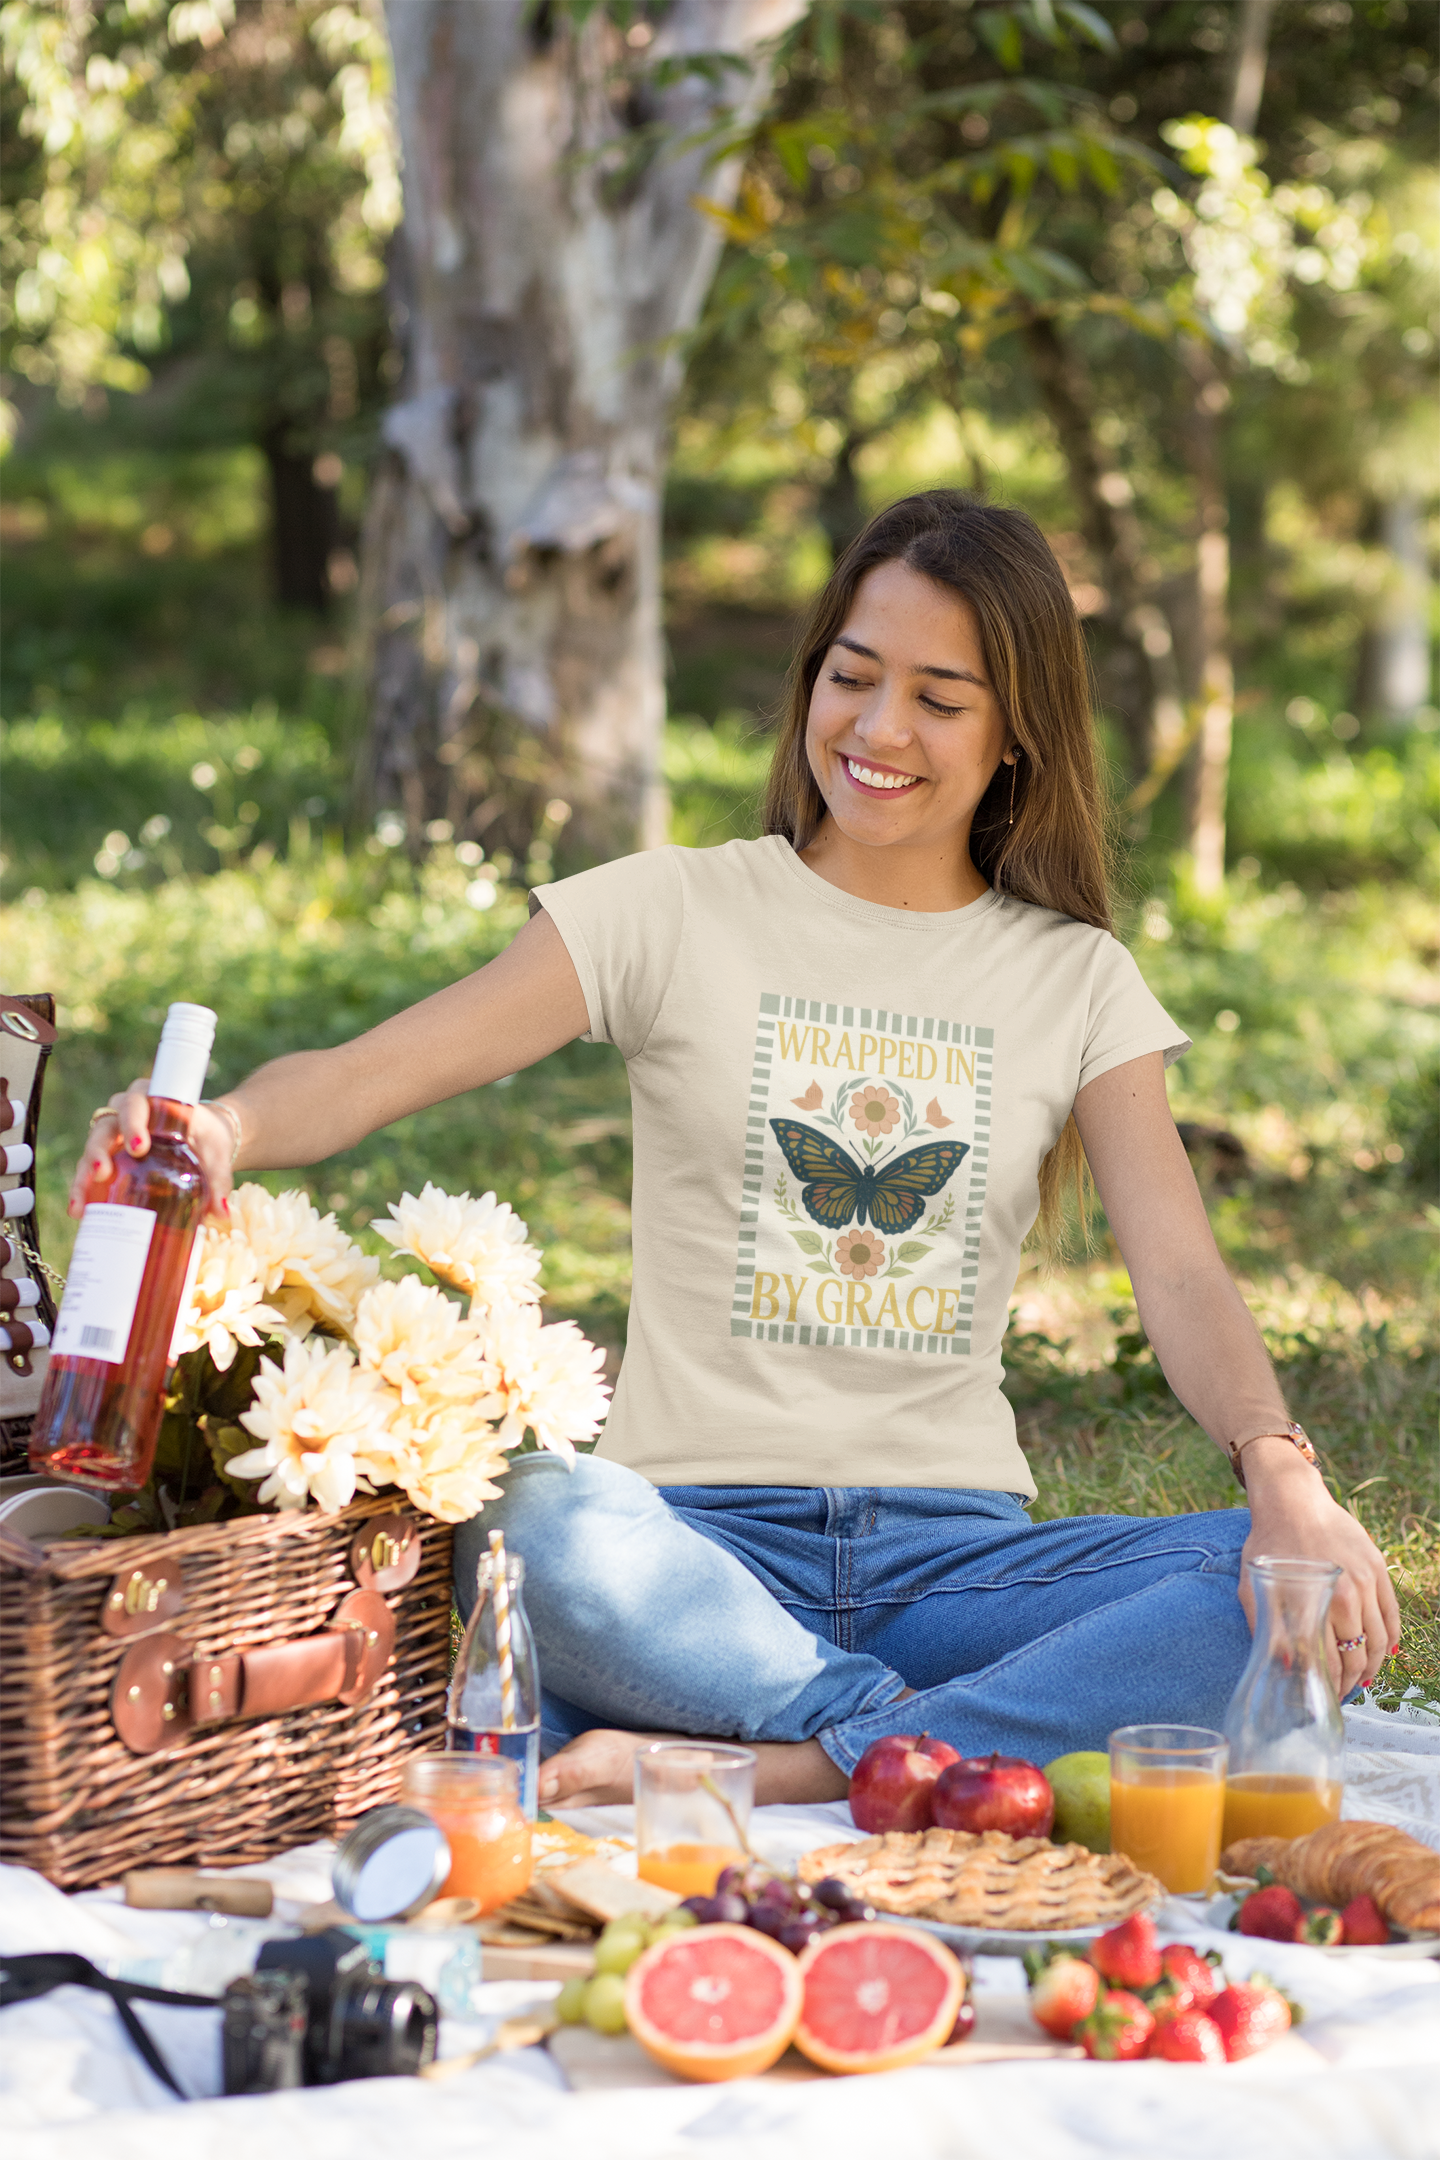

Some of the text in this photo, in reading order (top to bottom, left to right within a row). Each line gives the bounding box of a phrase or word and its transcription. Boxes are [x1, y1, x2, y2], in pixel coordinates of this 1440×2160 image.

[777, 1021, 977, 1087] WRAPPED IN
[749, 1271, 961, 1335] BY GRACE
